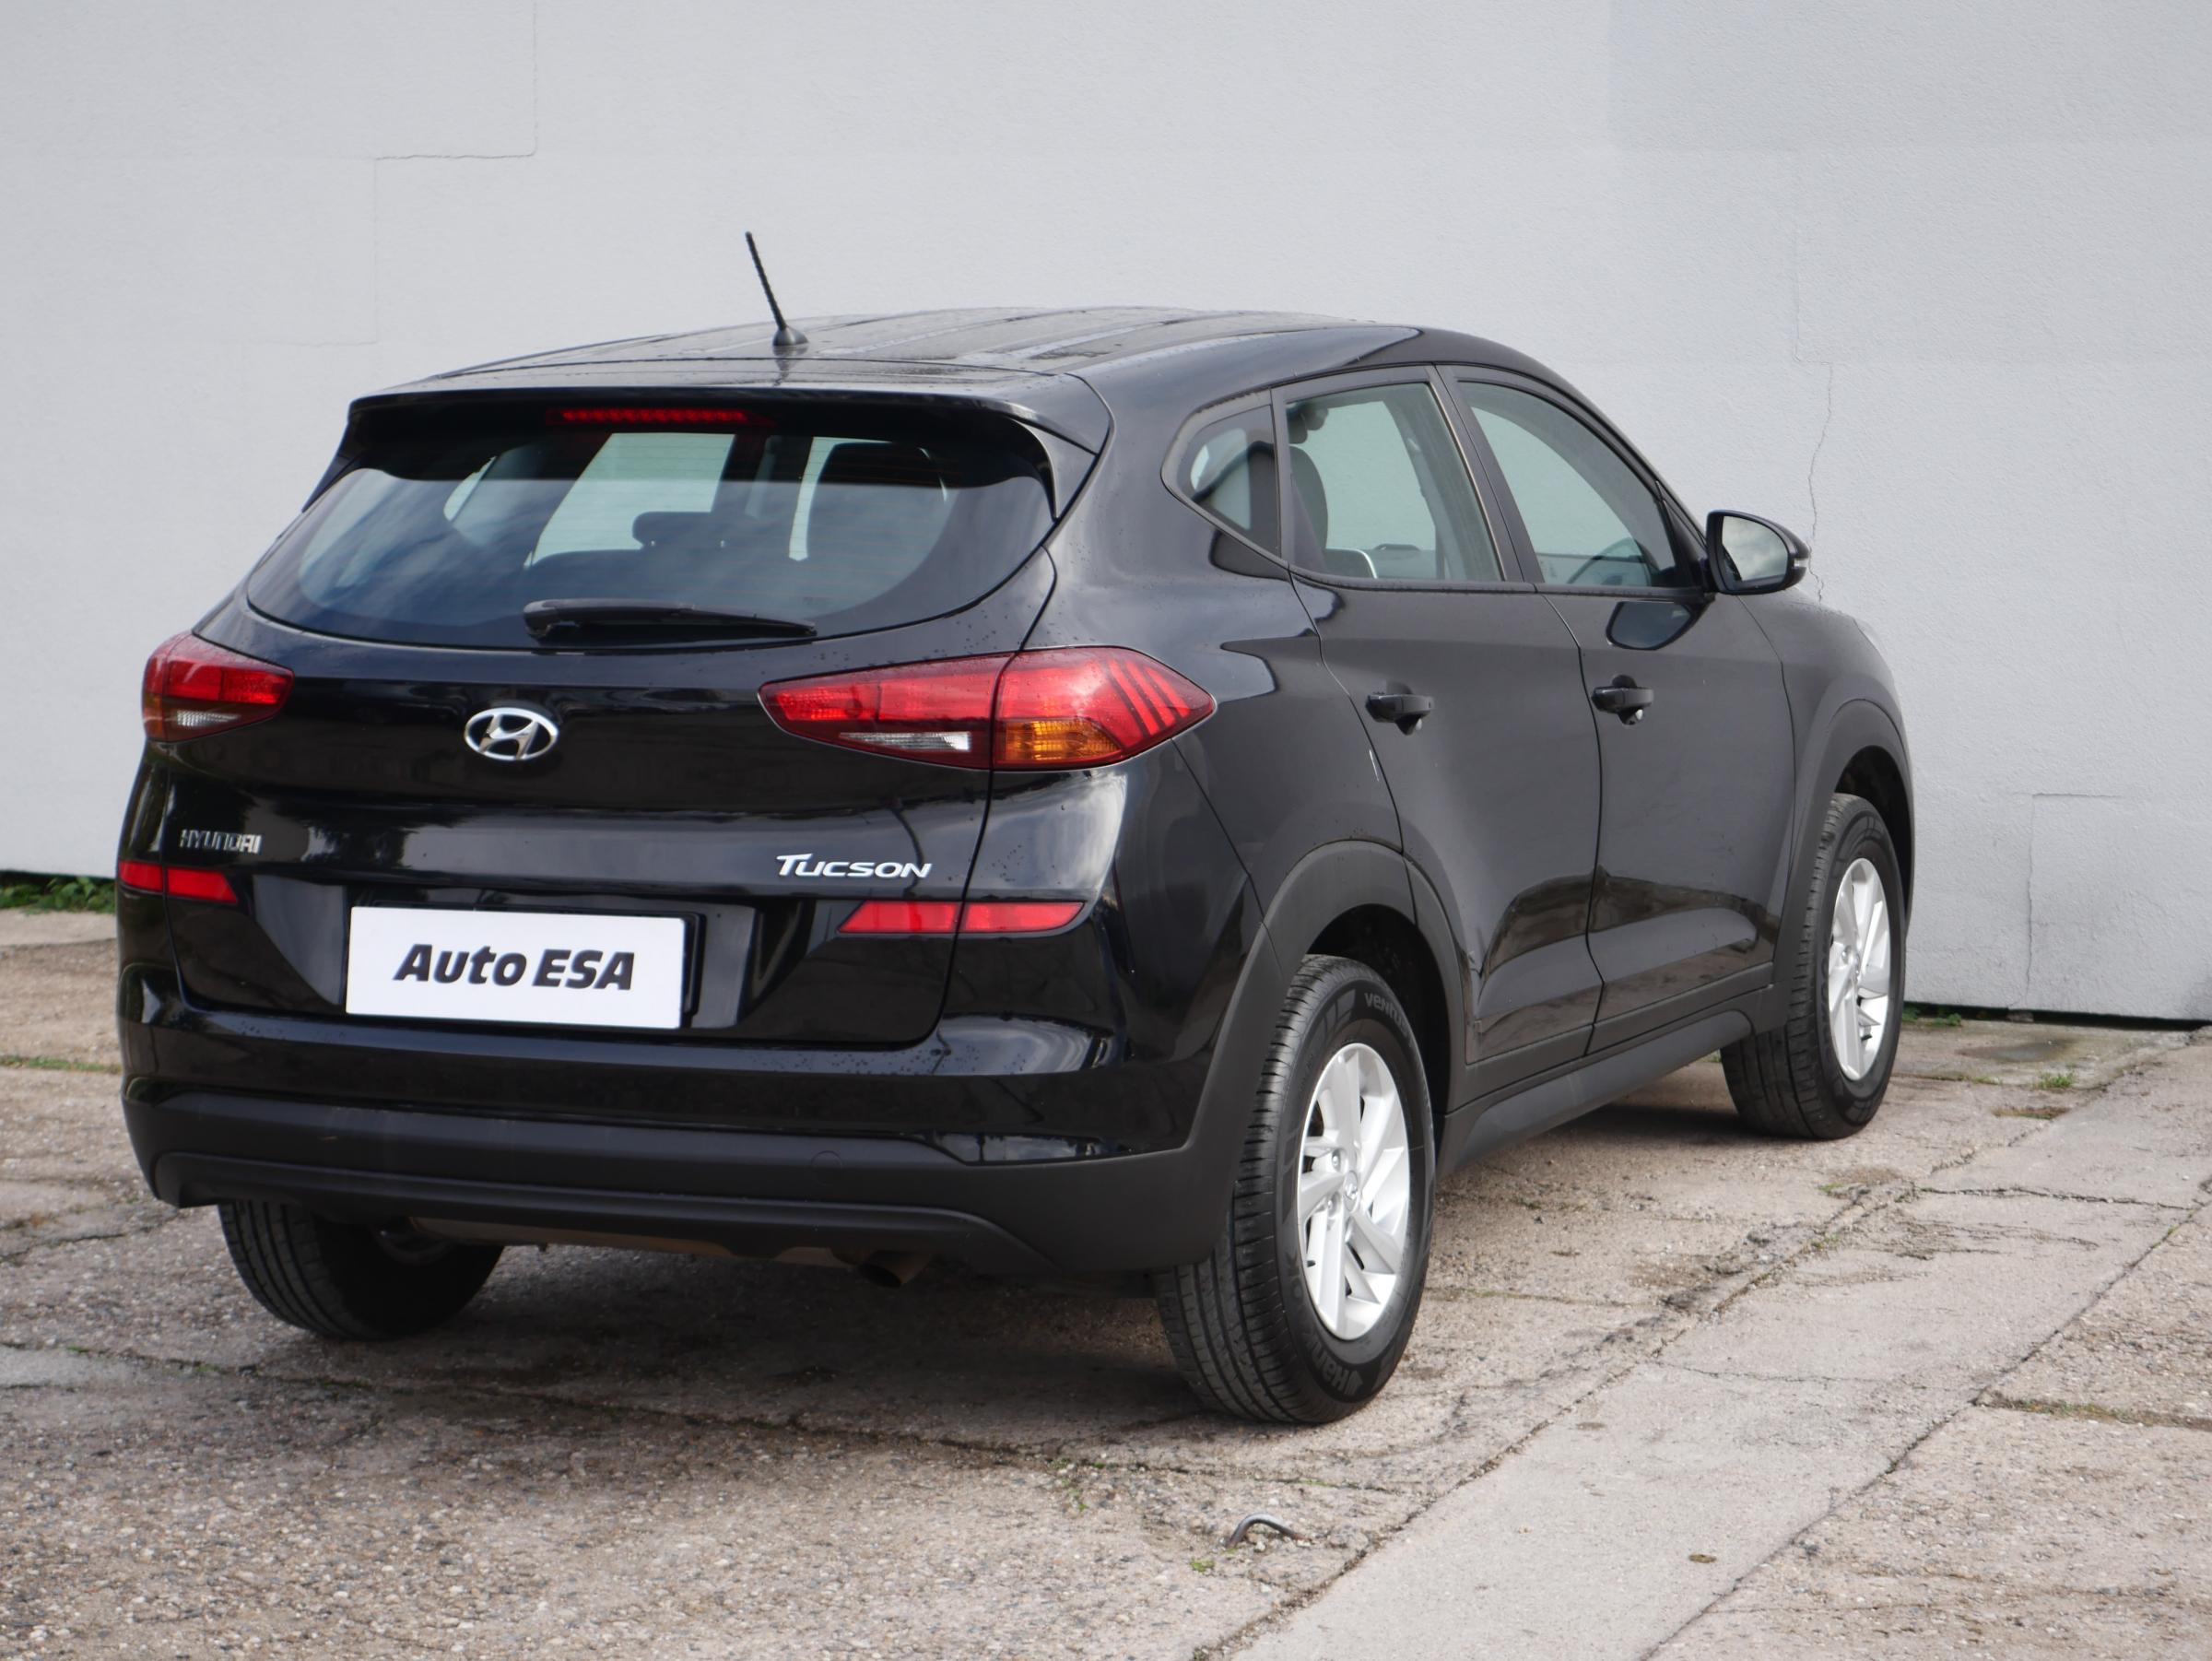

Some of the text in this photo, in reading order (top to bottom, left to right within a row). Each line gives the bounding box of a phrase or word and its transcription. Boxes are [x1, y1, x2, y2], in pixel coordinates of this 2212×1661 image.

[179, 829, 262, 854] HYUNDAI
[776, 854, 933, 878] TUCSON
[392, 943, 635, 991] Auto ESA
